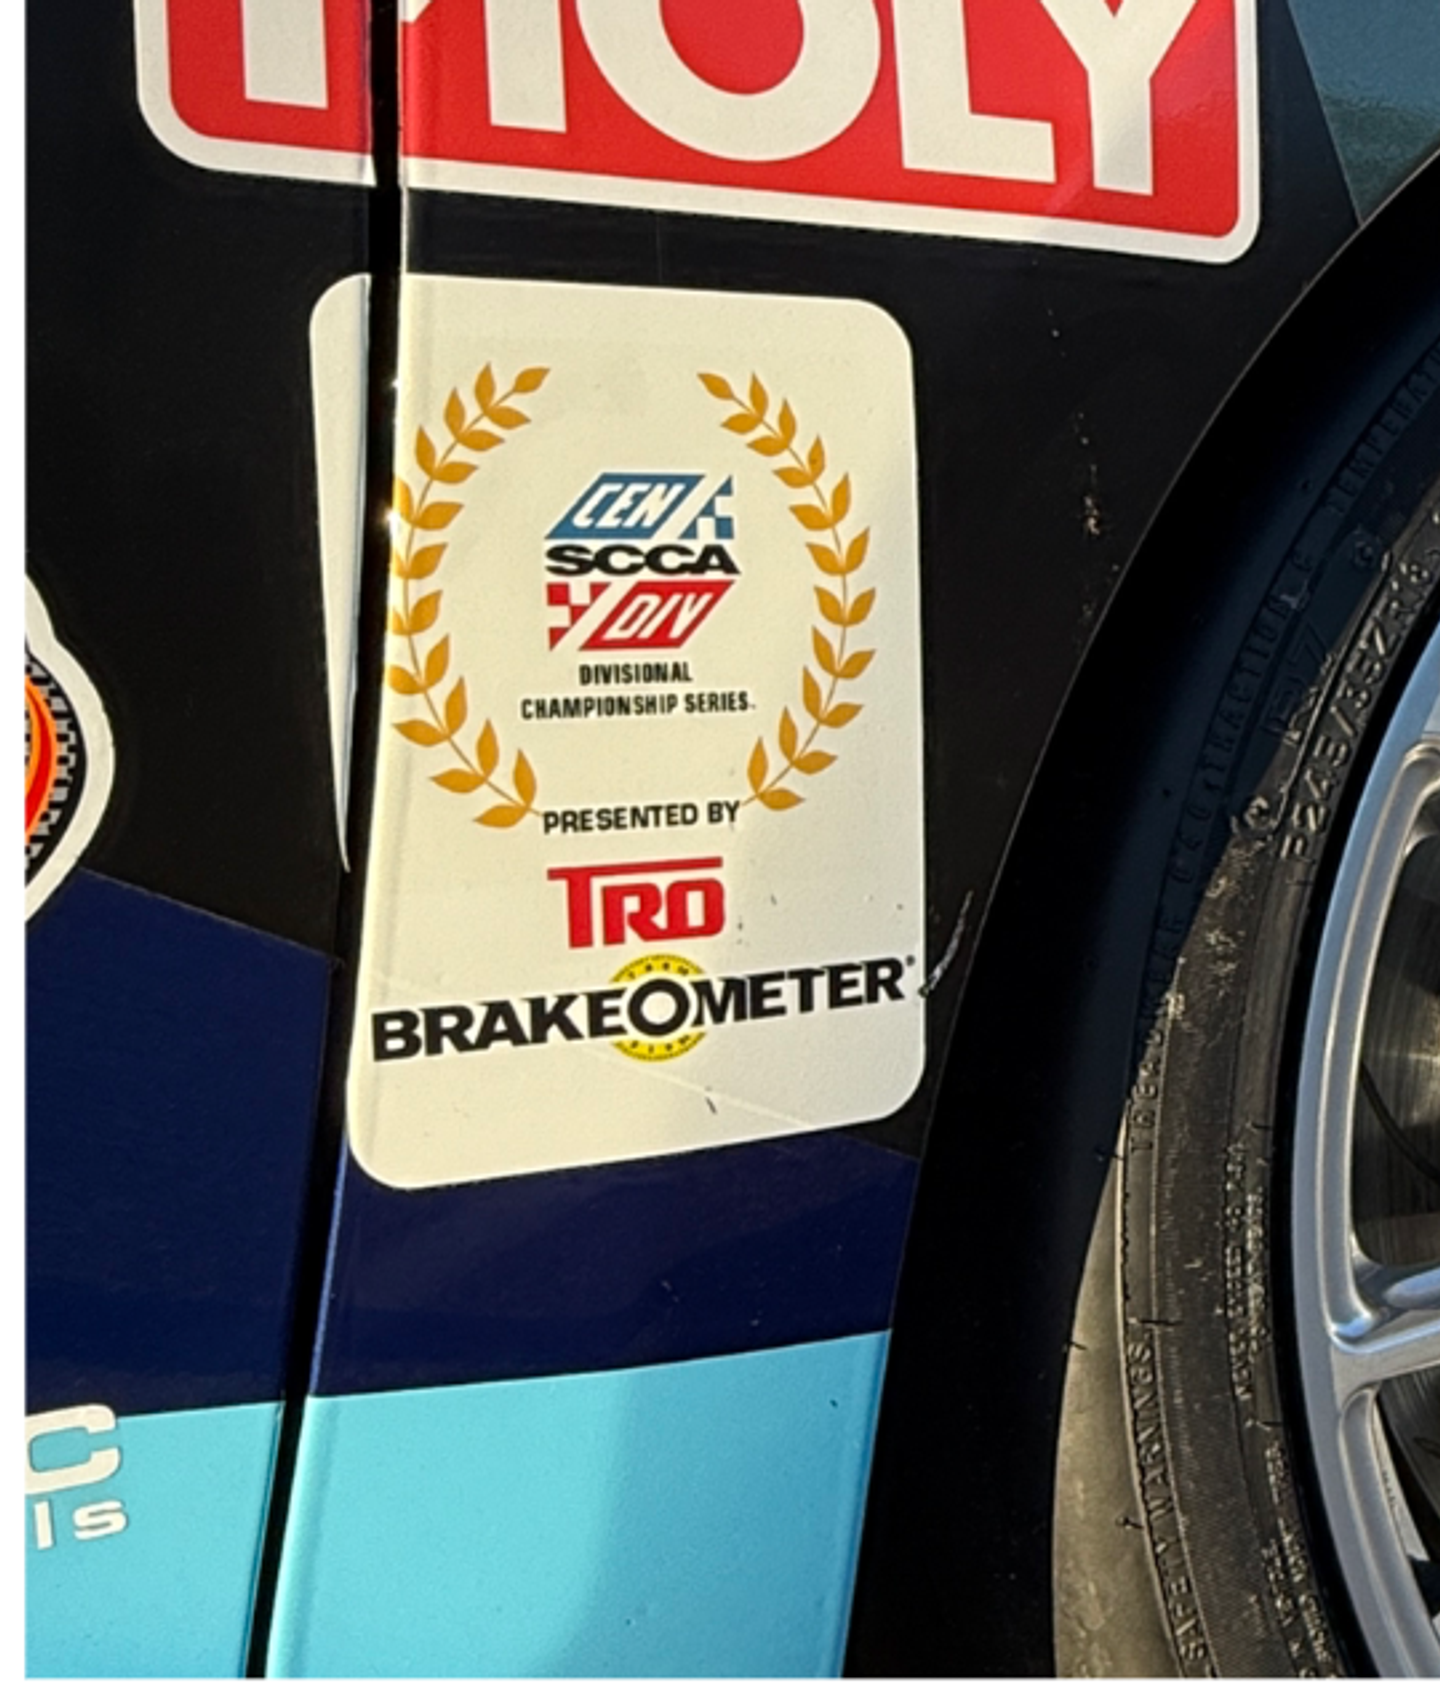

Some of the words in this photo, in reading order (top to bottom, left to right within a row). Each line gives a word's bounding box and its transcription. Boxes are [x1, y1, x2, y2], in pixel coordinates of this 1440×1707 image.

[573, 480, 676, 532] CEN
[545, 541, 741, 577] SCCA
[618, 590, 713, 642] DIV
[579, 661, 693, 686] DIVISIONAL
[521, 692, 679, 720] CHAMPIONSHIP
[543, 803, 701, 836] PRESENTED
[707, 801, 741, 826] BY
